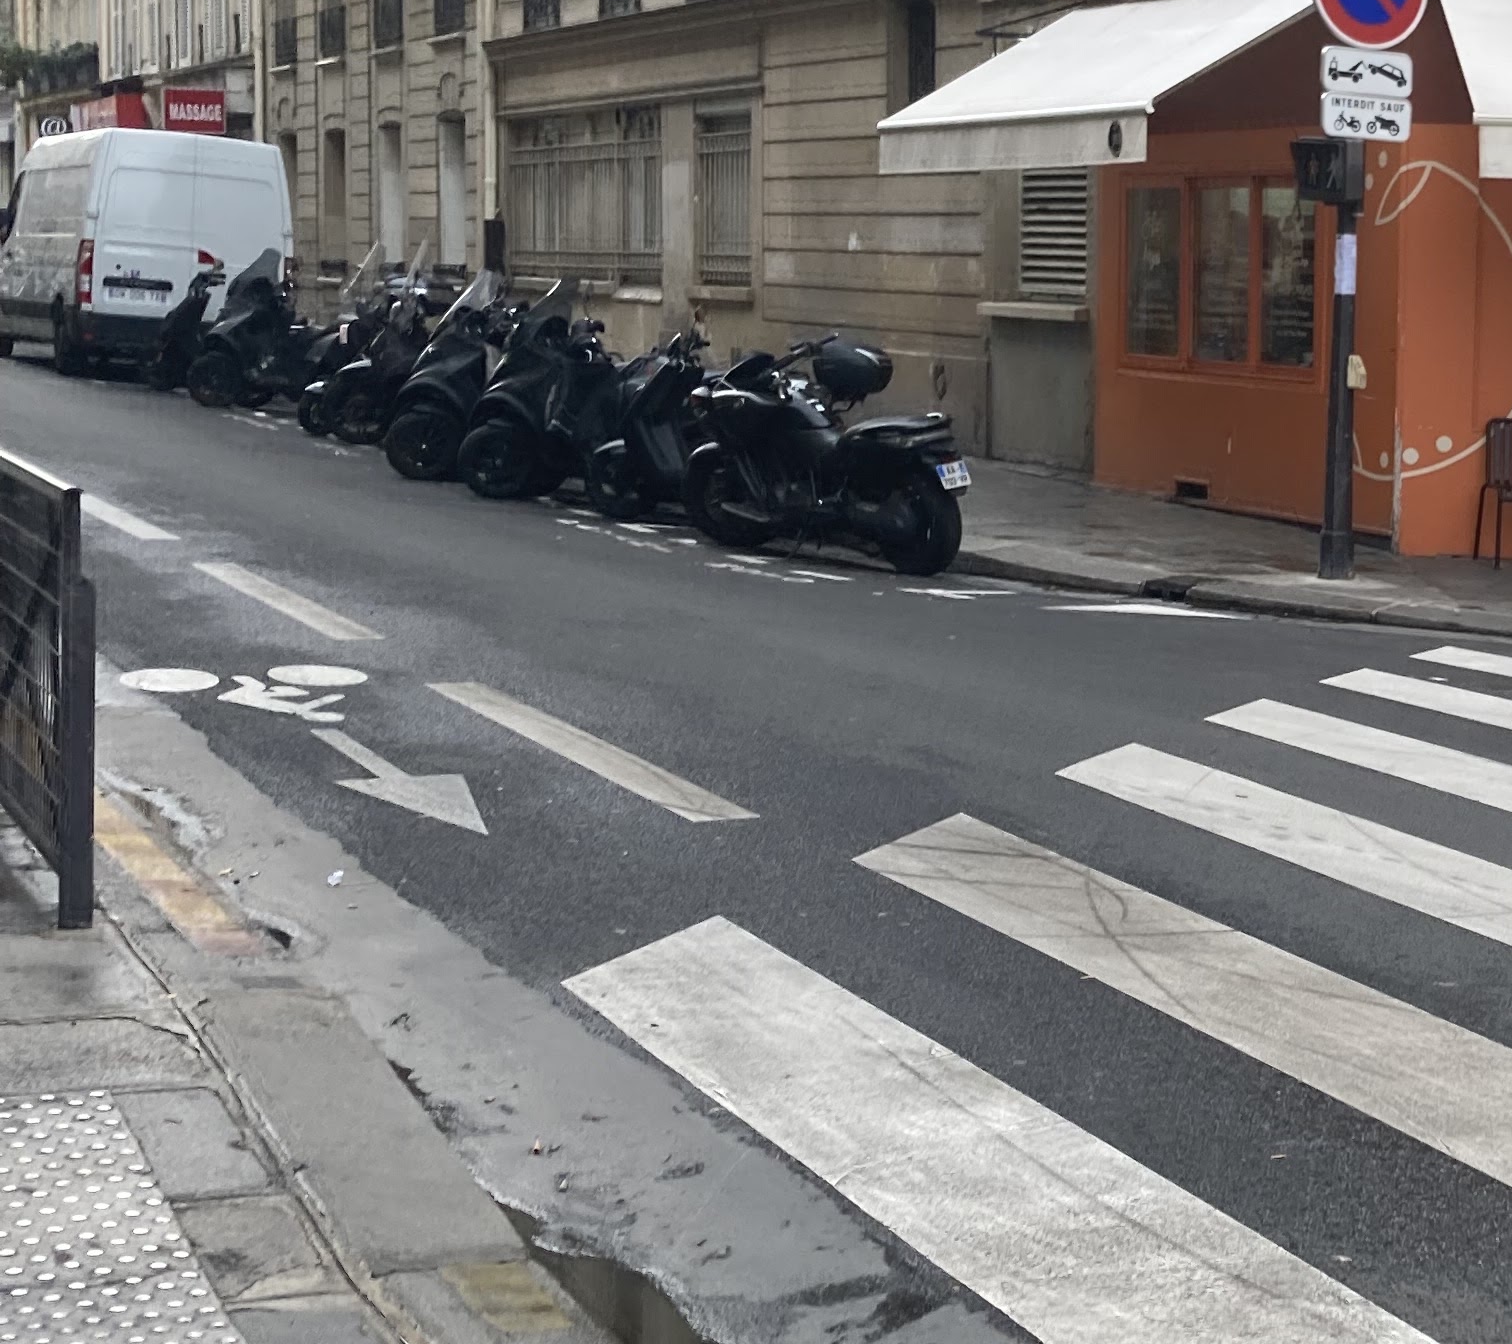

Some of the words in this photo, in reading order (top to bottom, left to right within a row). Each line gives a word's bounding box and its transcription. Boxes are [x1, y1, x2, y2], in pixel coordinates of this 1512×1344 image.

[169, 103, 222, 121] MASSAGE
[1331, 97, 1376, 111] INTERDIT
[1380, 102, 1405, 113] SAUF
